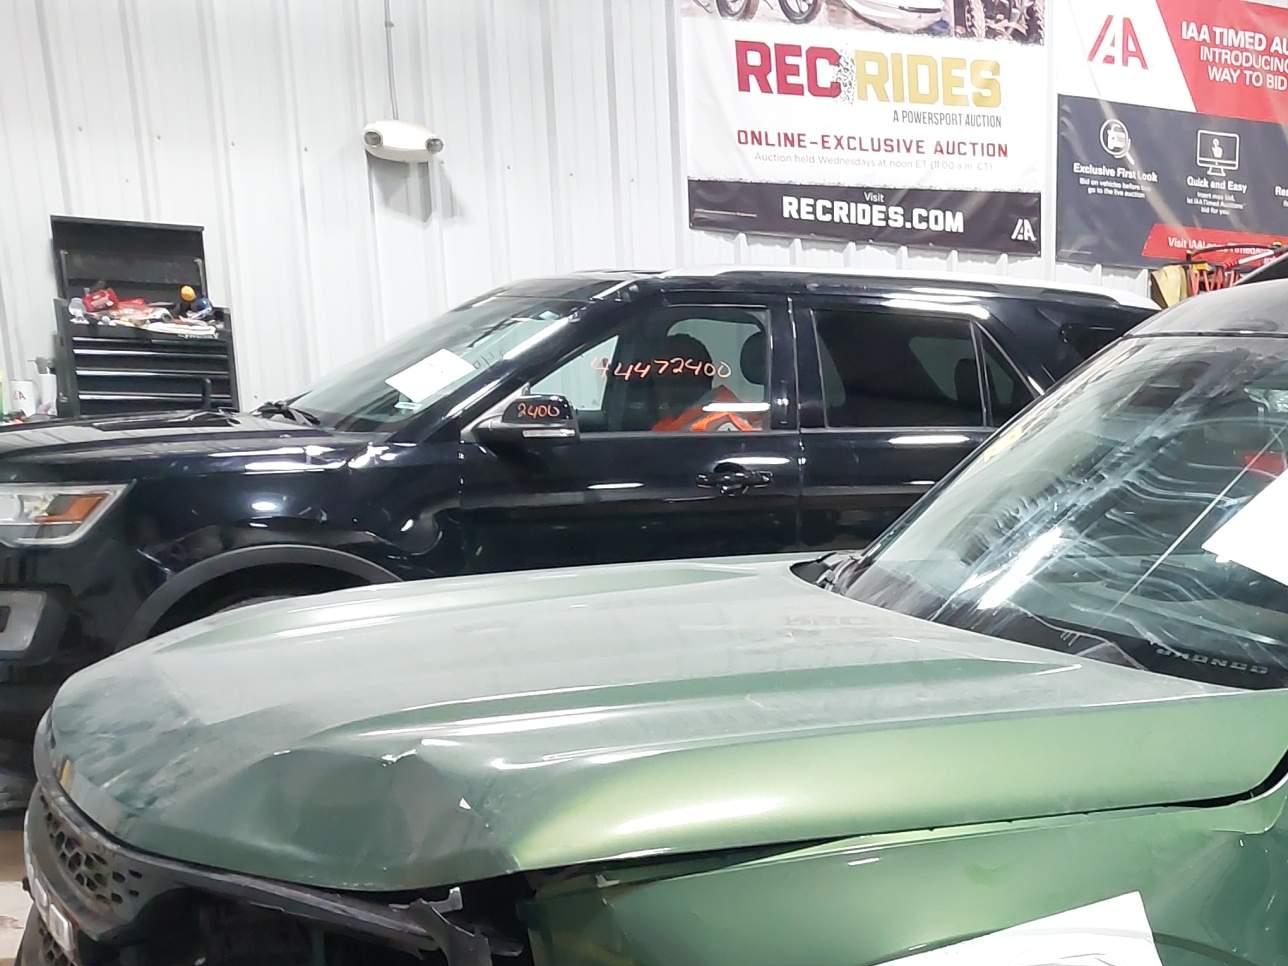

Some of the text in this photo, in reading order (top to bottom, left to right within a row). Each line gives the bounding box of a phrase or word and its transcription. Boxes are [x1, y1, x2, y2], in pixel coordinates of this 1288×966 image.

[1181, 21, 1211, 43] IAA
[1212, 27, 1266, 52] TIMED
[1208, 65, 1240, 84] WAY
[1243, 70, 1263, 87] TO
[1265, 74, 1287, 91] BID
[892, 109, 1002, 128] A POWERSPORT AUCTION
[737, 130, 1009, 158] ONLINE-EXCLUSIVE AUCTION
[754, 152, 792, 163] Auction
[795, 154, 815, 164] held
[818, 156, 876, 168] Wednesdays
[889, 160, 912, 169] noon
[1073, 162, 1159, 182] Exclusive First Look
[1187, 176, 1247, 194] Quick and Easy
[863, 191, 885, 203] Visit
[783, 195, 965, 233] RECRIDES.COM
[1168, 236, 1187, 248] Visit
[590, 357, 732, 381] 44472400
